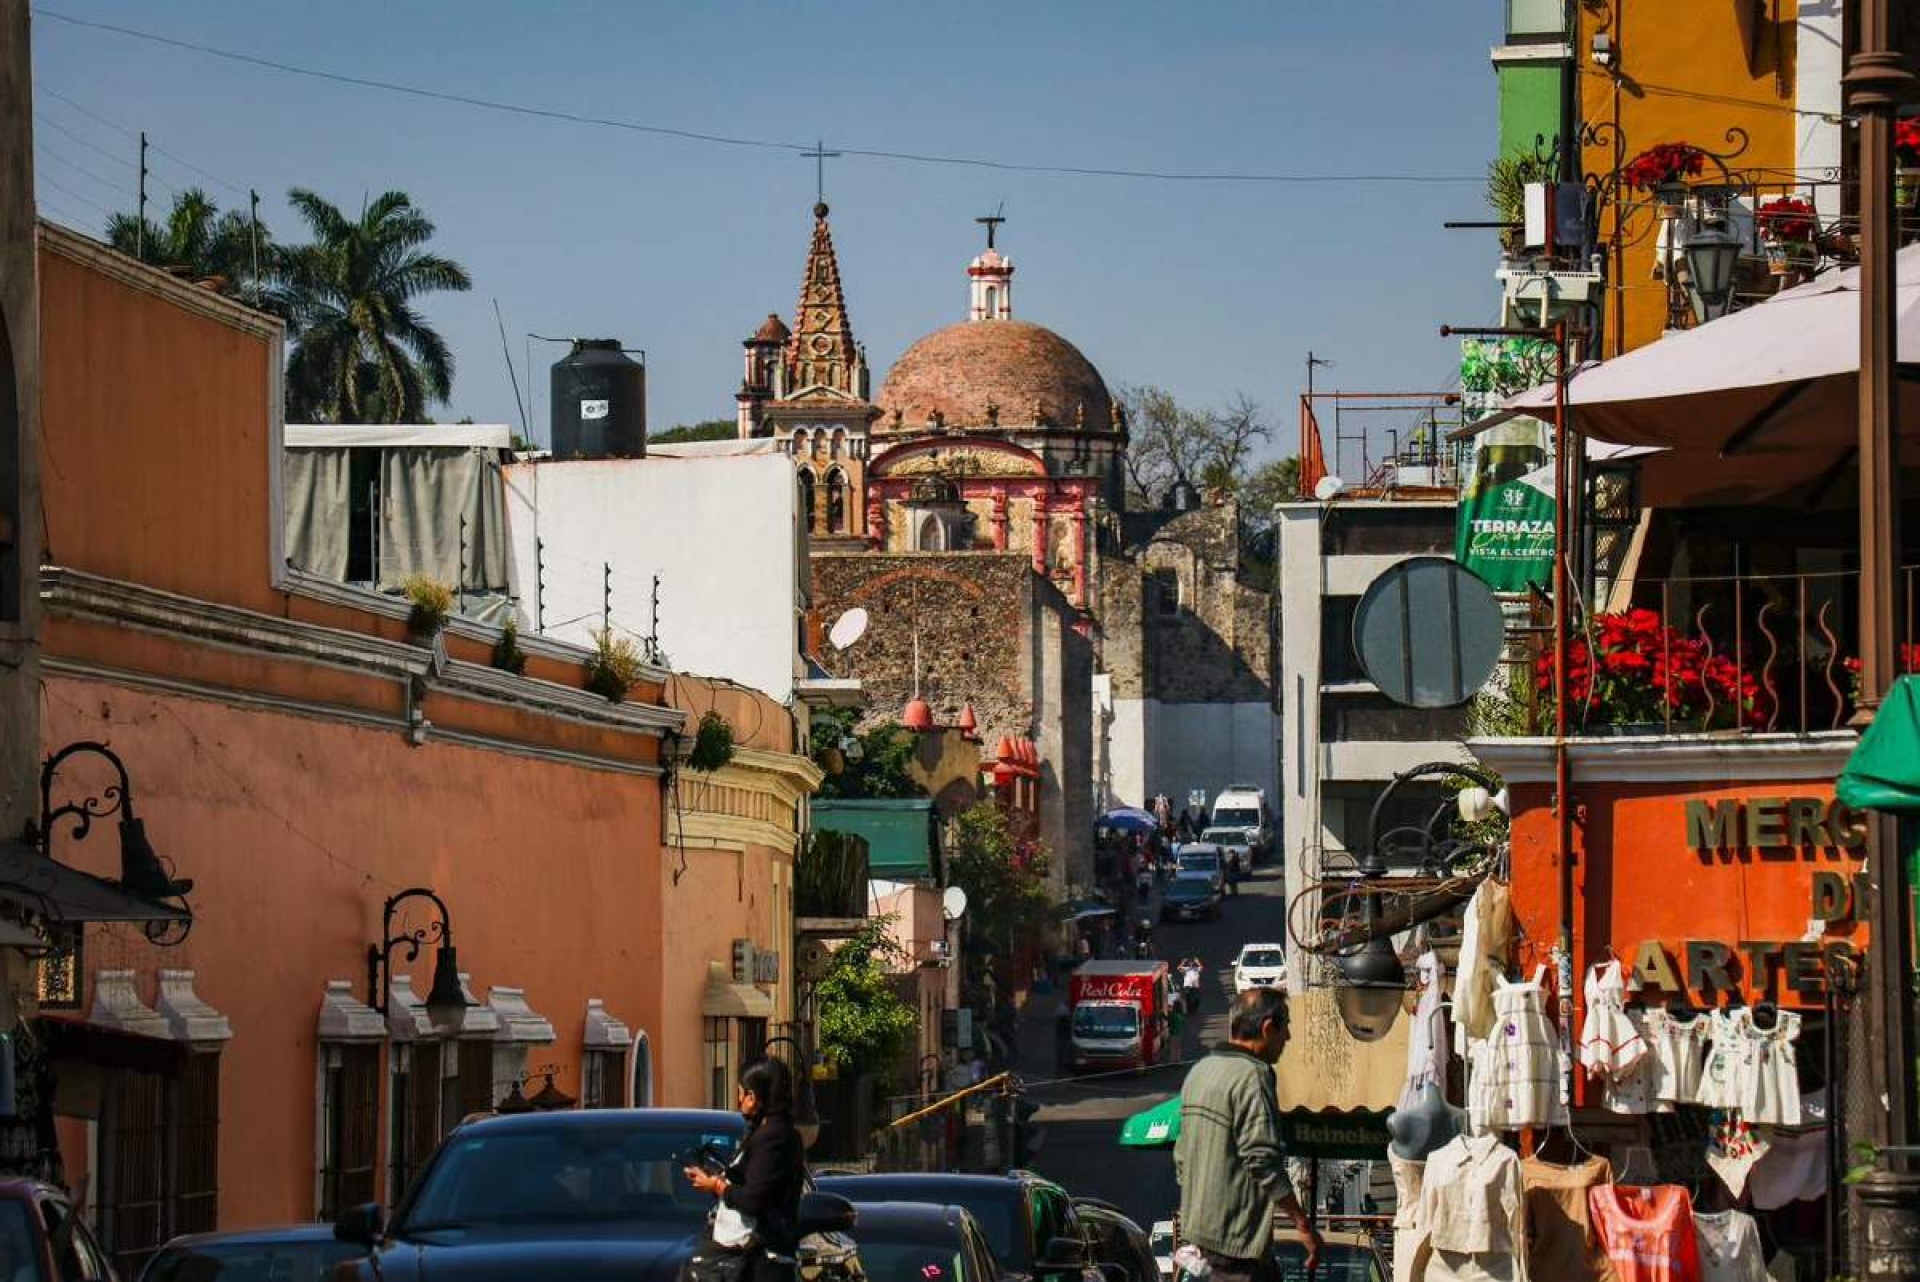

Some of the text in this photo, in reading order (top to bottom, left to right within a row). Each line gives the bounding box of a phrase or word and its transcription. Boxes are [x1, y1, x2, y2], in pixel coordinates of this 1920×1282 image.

[1470, 519, 1555, 533] TERRAZA
[1469, 548, 1497, 556] VISTA
[1515, 548, 1555, 556] CENTRO
[1079, 981, 1143, 997] Red Cola
